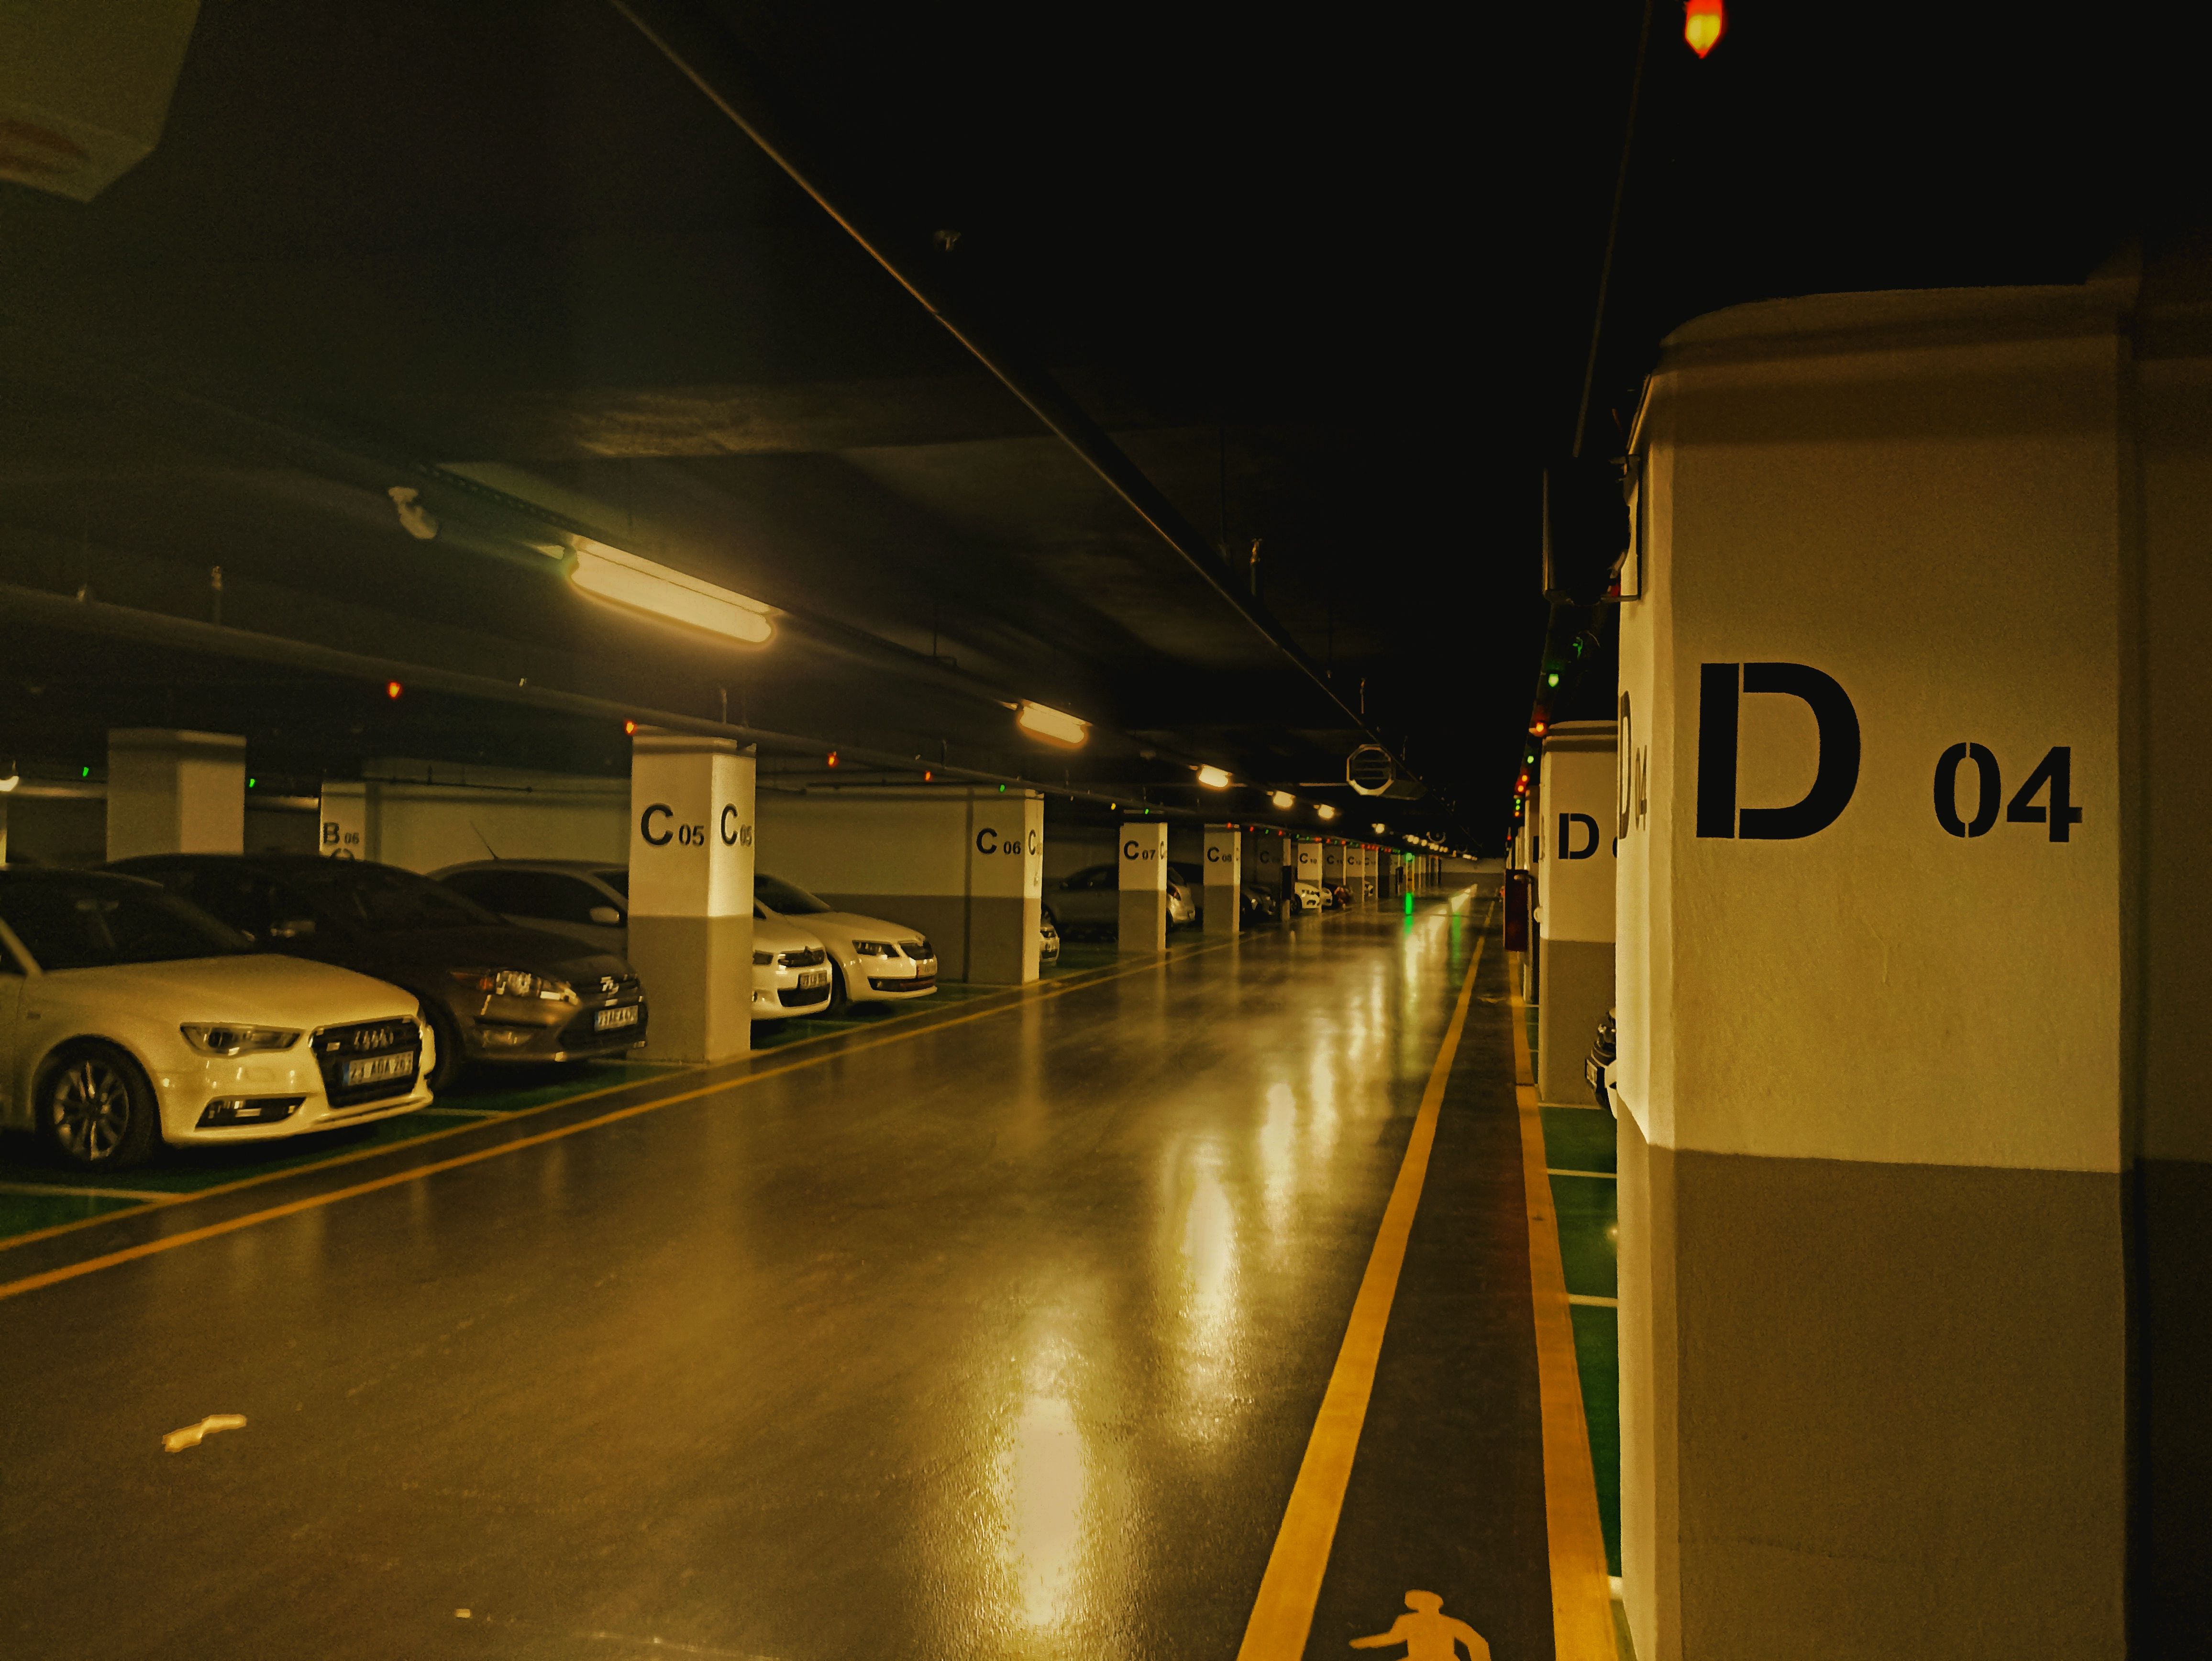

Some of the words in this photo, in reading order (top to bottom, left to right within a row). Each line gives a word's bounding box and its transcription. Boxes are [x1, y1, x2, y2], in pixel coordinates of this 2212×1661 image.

[1697, 662, 1861, 839] D
[1934, 742, 2082, 842] 04
[323, 822, 340, 845] B
[641, 804, 674, 846] C
[679, 824, 705, 846] 05
[721, 803, 738, 846] C
[740, 824, 752, 847] 05
[1559, 813, 1599, 859] D
[976, 828, 997, 855] C
[1003, 841, 1021, 855] 06
[1029, 829, 1036, 855] C
[1124, 841, 1139, 860] C
[1142, 850, 1156, 860] 07
[1207, 847, 1219, 862] C
[1260, 850, 1269, 864] C
[1299, 853, 1308, 864] C
[1327, 855, 1334, 864] C
[1348, 856, 1354, 865] C
